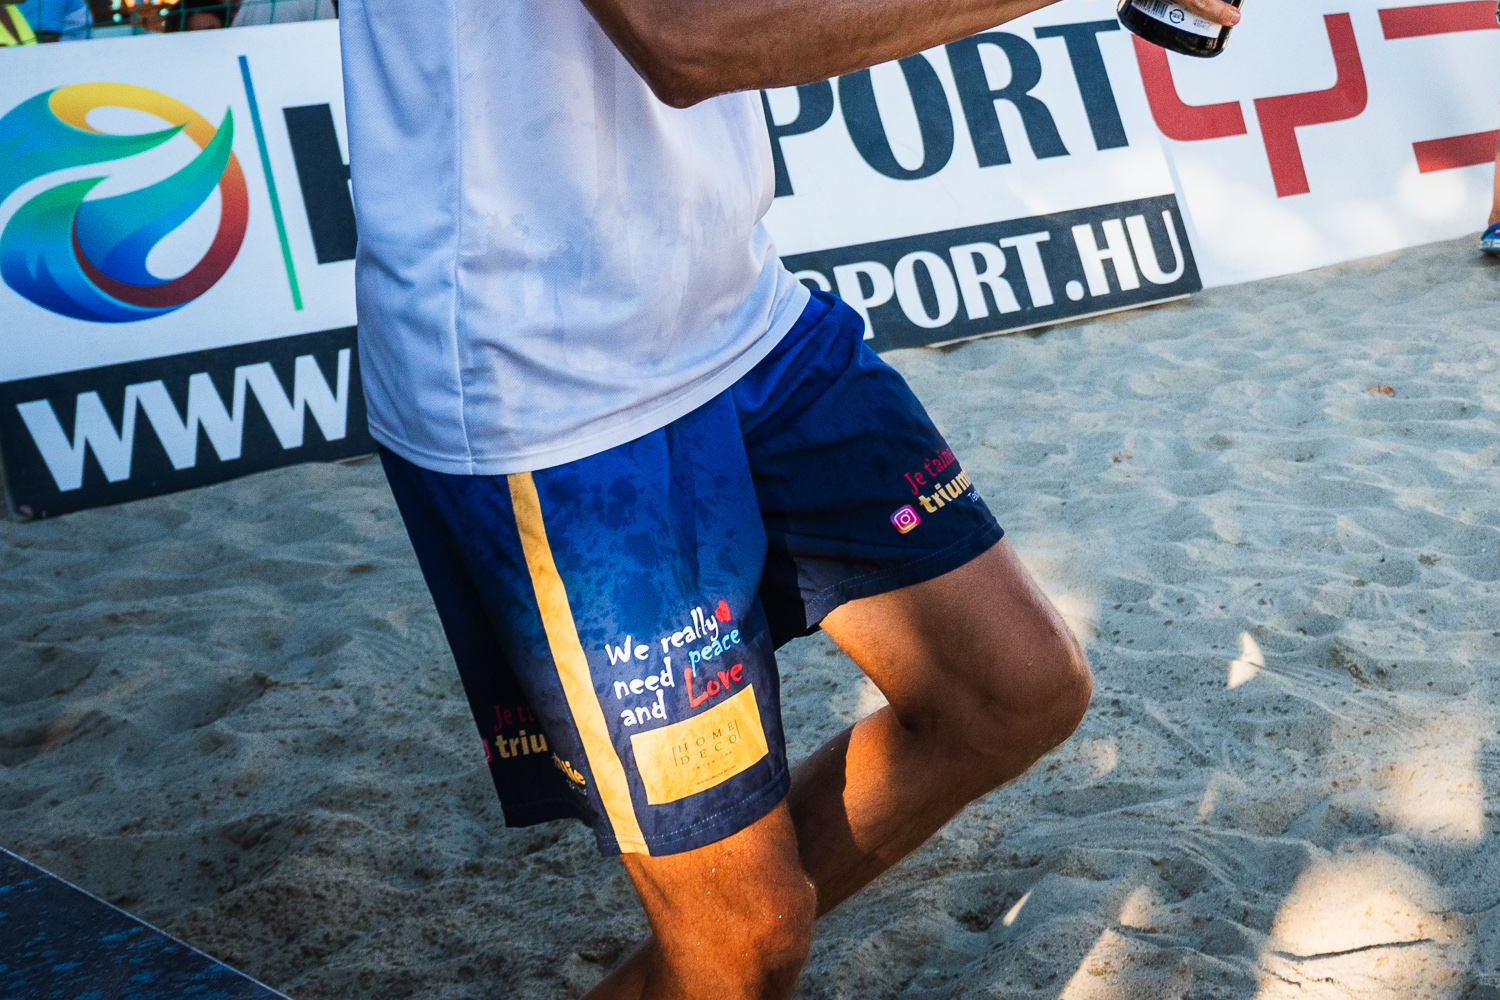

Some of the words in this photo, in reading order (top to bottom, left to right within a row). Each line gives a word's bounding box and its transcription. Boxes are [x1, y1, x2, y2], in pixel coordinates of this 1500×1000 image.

[903, 472, 927, 495] Je
[604, 634, 649, 666] We
[661, 606, 719, 653] really
[613, 656, 675, 700] need
[688, 628, 741, 677] peace
[620, 688, 667, 727] and
[683, 663, 743, 708] Love
[493, 704, 513, 732] Je
[678, 721, 735, 753] HOME
[680, 734, 737, 765] DECO
